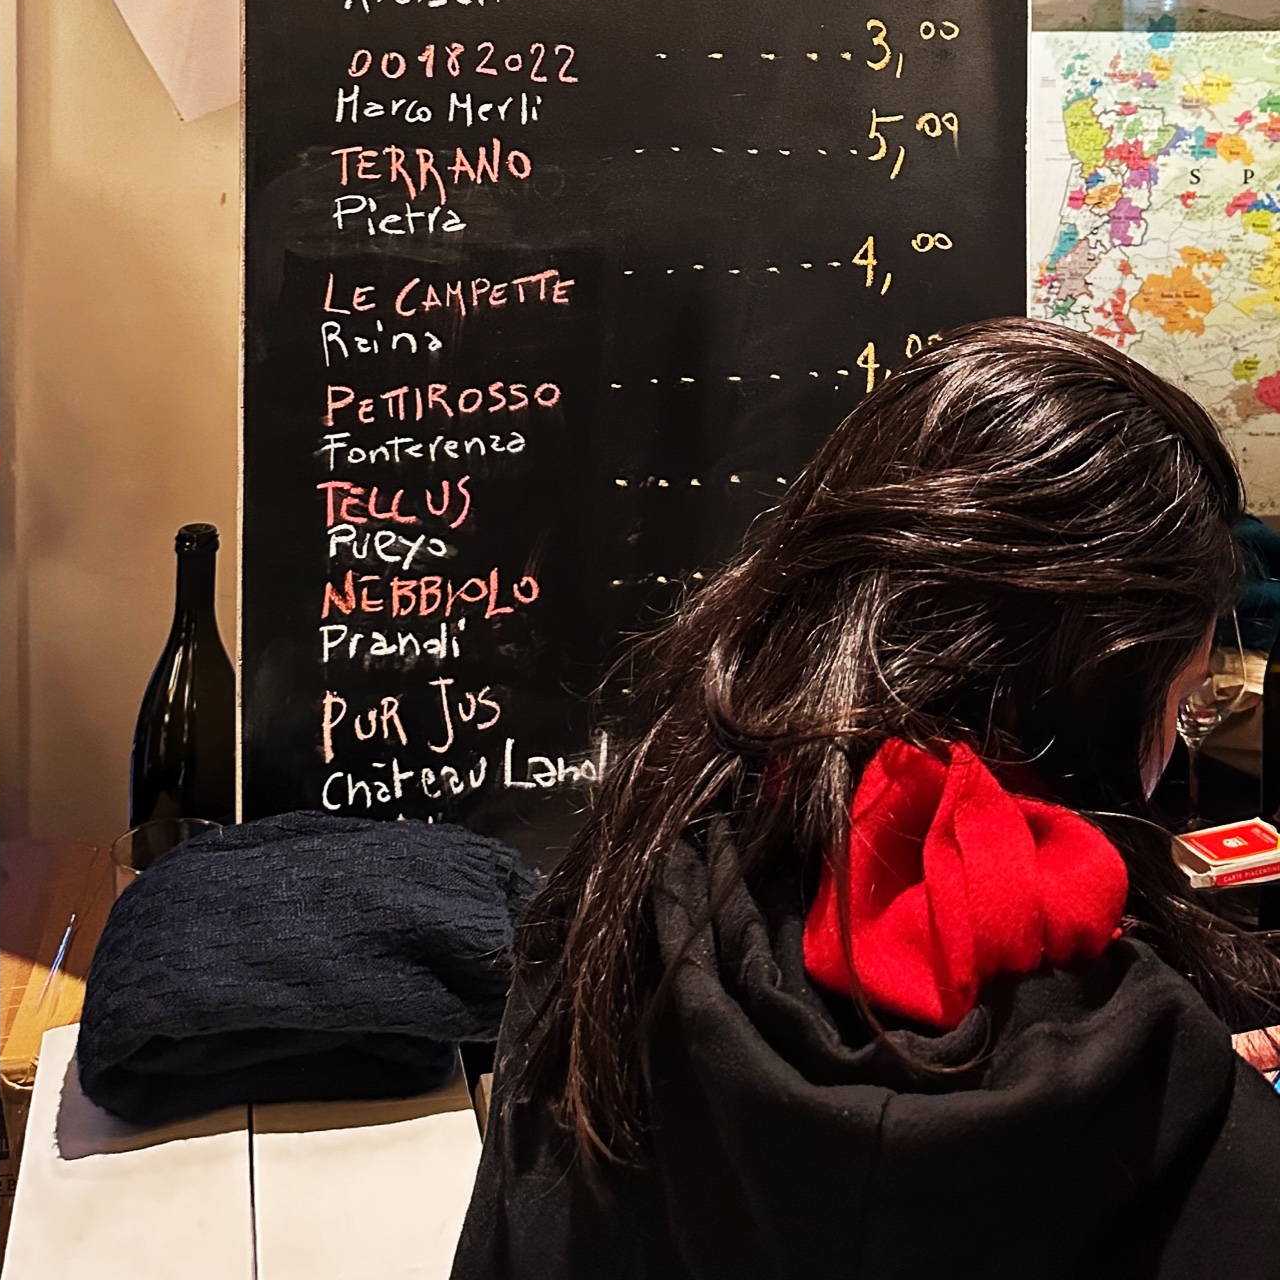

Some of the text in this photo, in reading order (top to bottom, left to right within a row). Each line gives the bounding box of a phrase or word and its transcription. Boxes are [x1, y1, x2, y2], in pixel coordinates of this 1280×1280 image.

[335, 84, 543, 127] Marco Merli
[330, 137, 532, 206] TERRANO
[332, 194, 467, 236] Pietra
[323, 272, 377, 315] LE
[395, 269, 575, 317] CAMPETTE
[321, 320, 444, 367] Raina
[322, 382, 562, 427] PETTIROSSO
[320, 432, 527, 471] Fonterenza
[316, 475, 471, 529] TELLUS
[327, 524, 448, 571] Pueyo
[321, 567, 541, 620] NEBBIOLO
[319, 617, 466, 663] Prandi
[321, 676, 501, 764] PUR JUS
